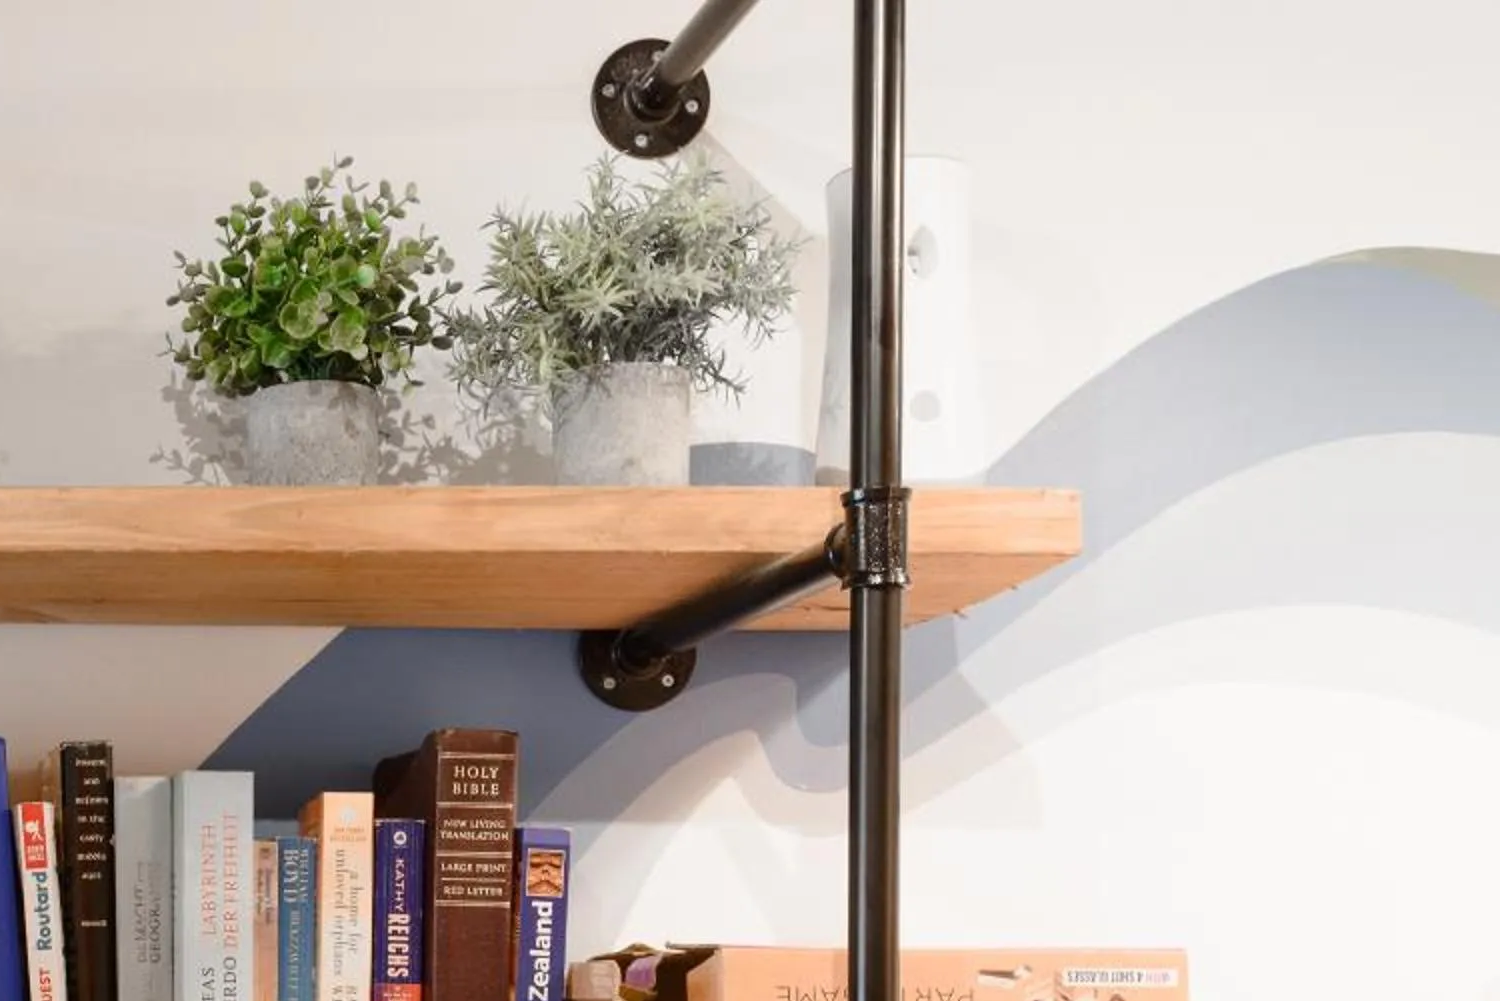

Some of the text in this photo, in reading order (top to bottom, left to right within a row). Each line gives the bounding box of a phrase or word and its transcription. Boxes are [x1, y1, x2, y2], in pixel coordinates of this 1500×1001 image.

[452, 782, 500, 796] BIBLE
[453, 765, 499, 779] HOLY
[440, 831, 509, 841] TRANSLATION
[443, 819, 506, 829] NEW LIVING
[200, 824, 217, 935] LABYRINTH
[282, 848, 300, 903] BOYD
[333, 848, 346, 909] unloved
[395, 858, 406, 913] KATHY
[441, 863, 506, 873] LARGE PRINT
[443, 886, 503, 896] RED LETTER
[31, 871, 51, 951] Routard
[350, 886, 363, 927] home
[331, 913, 347, 977] orphans
[386, 912, 410, 977] REICHS
